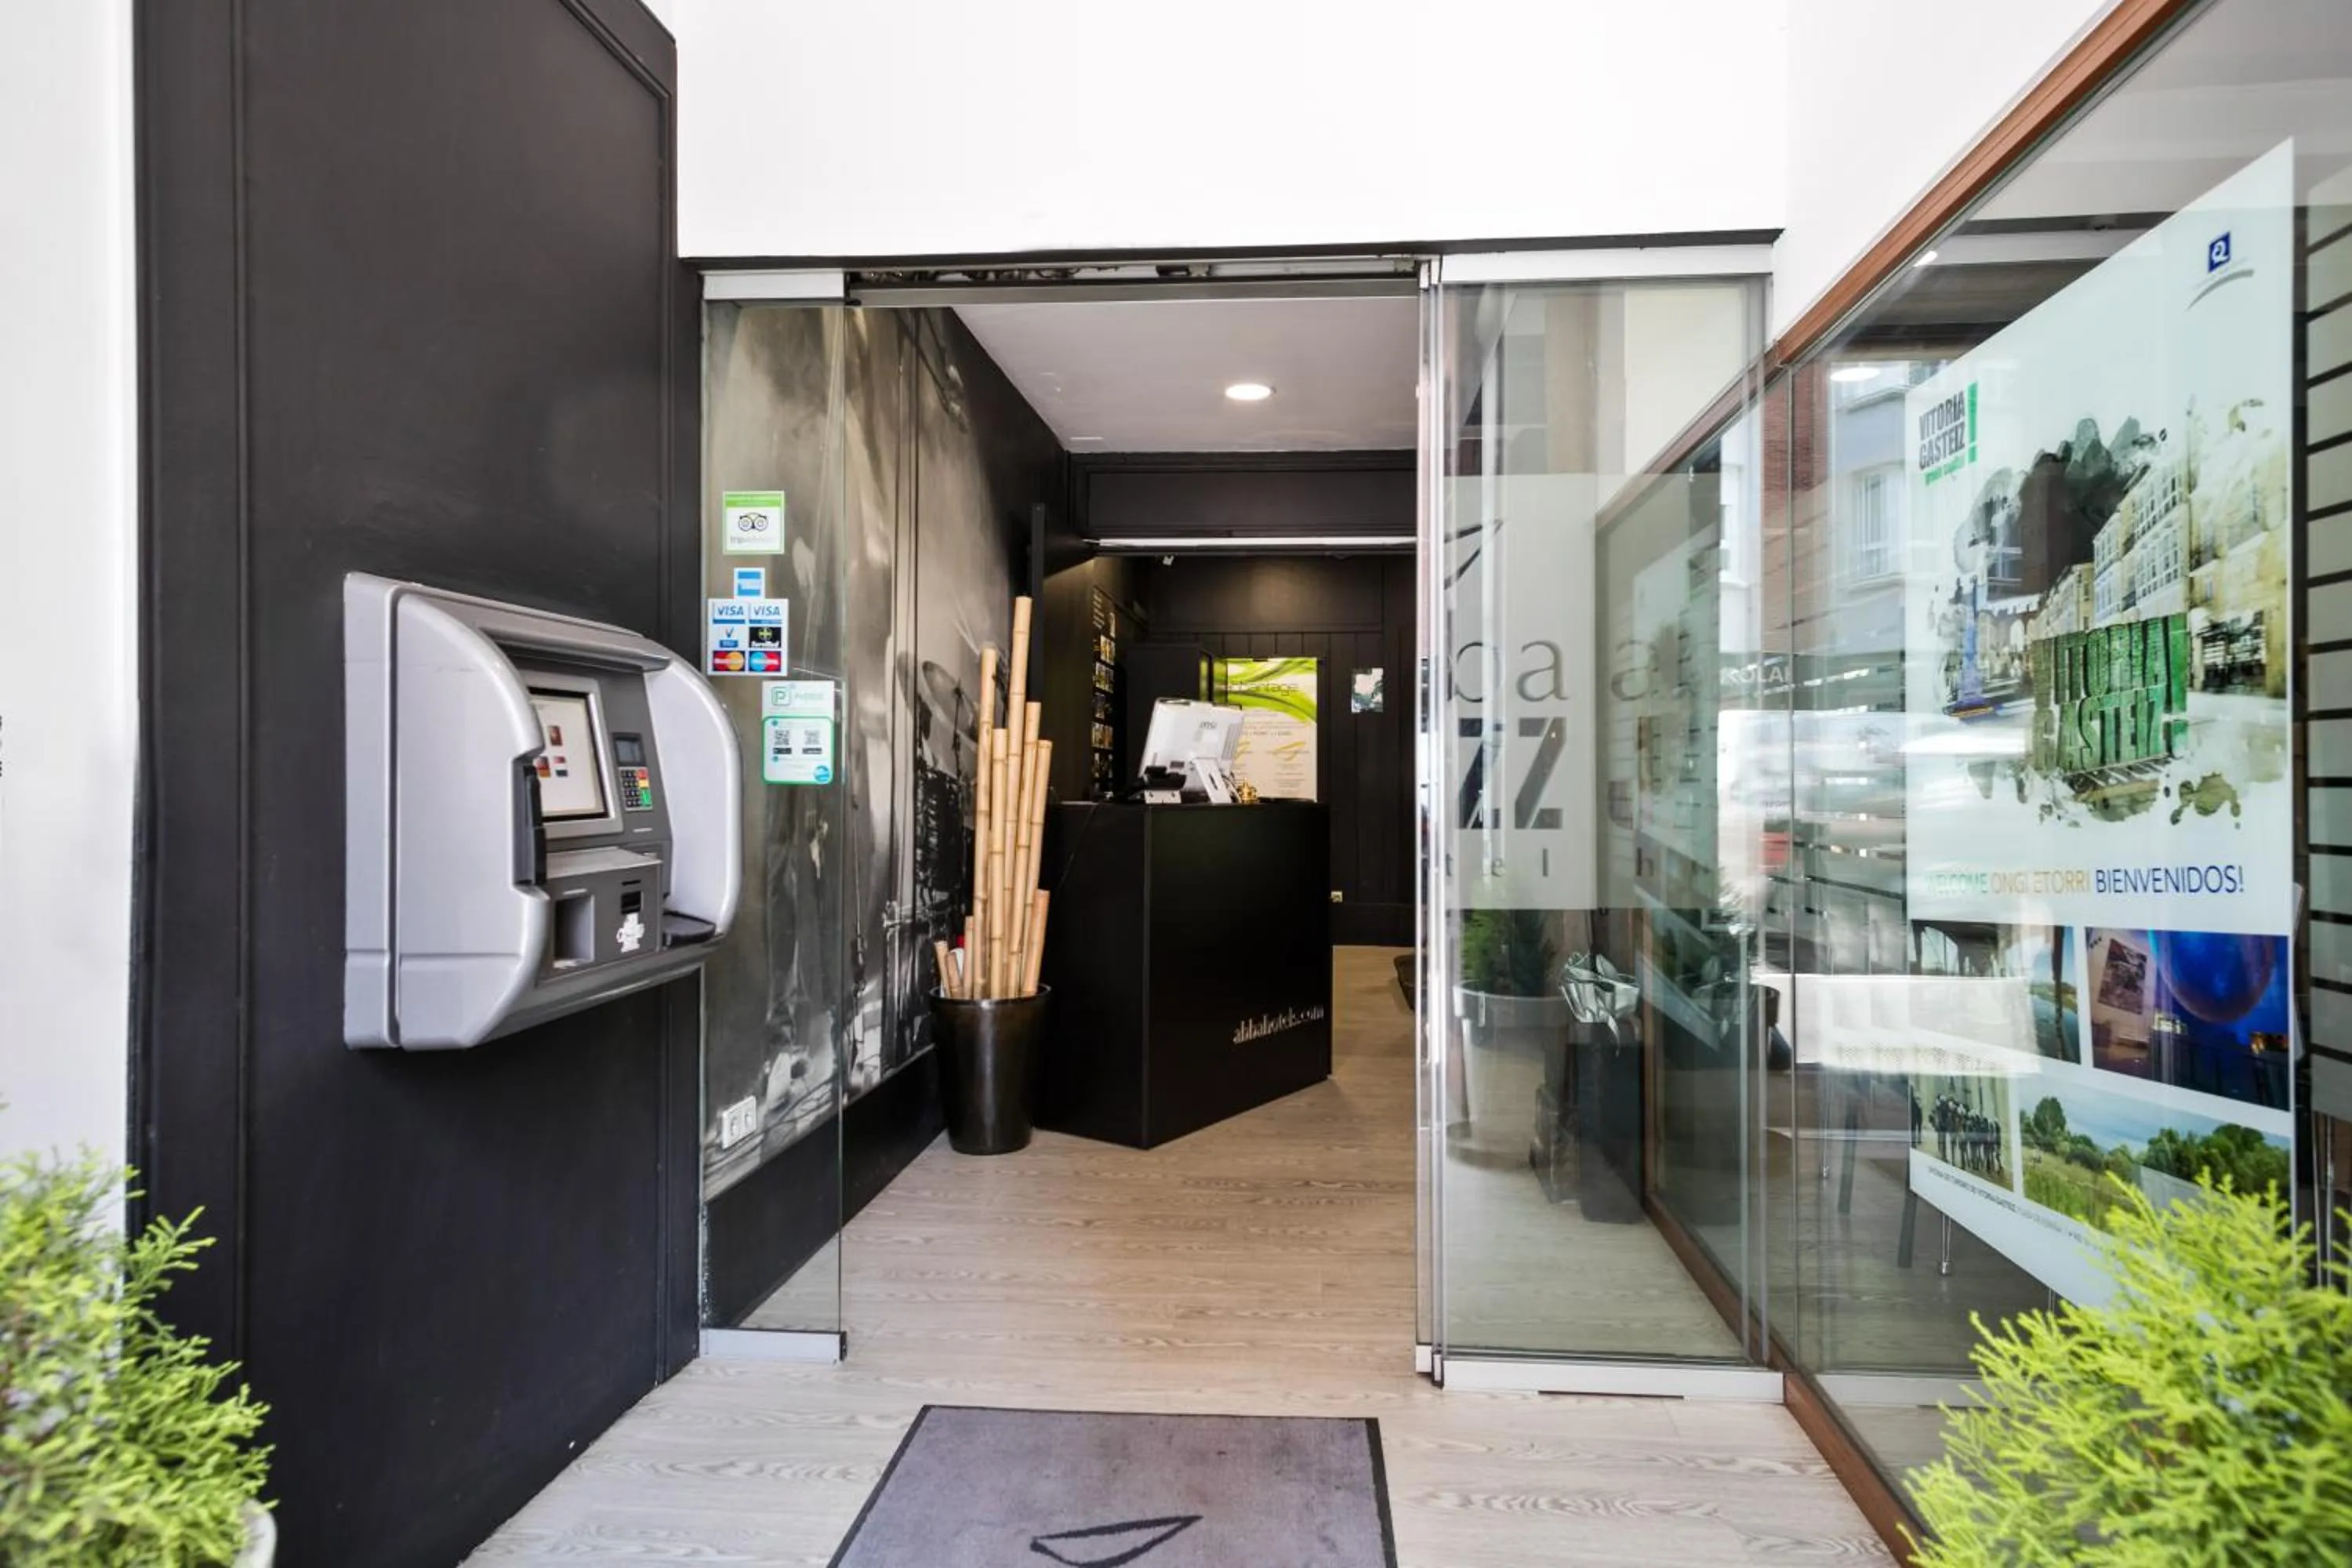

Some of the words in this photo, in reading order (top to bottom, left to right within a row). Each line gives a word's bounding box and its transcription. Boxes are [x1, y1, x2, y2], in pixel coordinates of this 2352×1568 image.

[1918, 390, 1965, 442] VITORIA
[1918, 421, 1965, 472] GASTEIZ
[717, 604, 745, 616] VISA
[753, 604, 781, 616] VISA
[2095, 865, 2245, 894] BIENVENIDOS!
